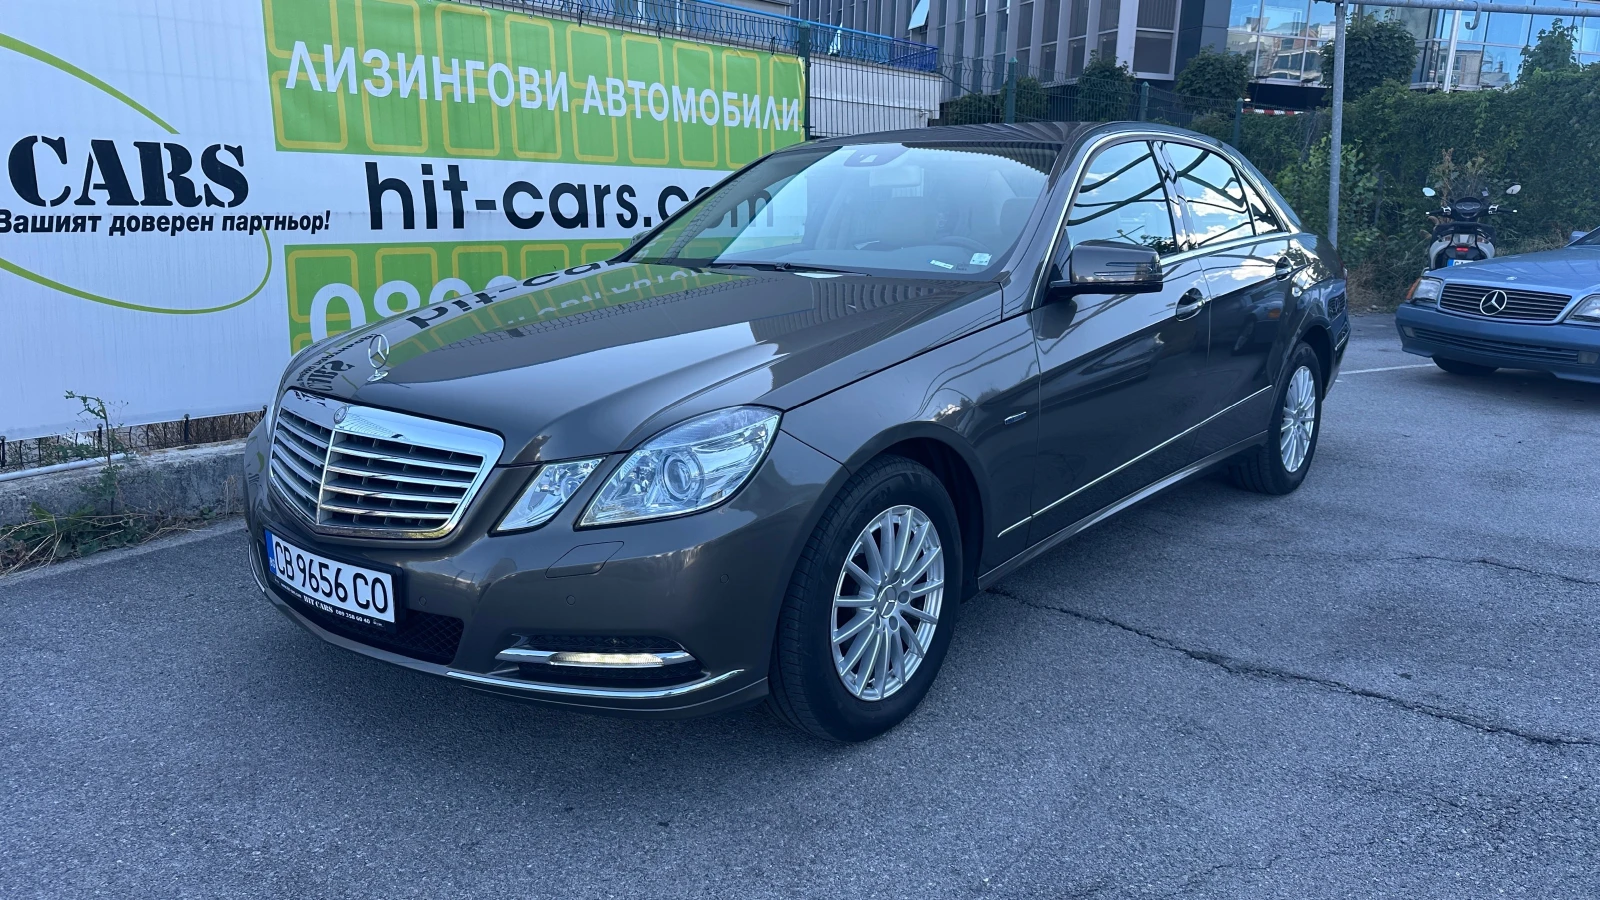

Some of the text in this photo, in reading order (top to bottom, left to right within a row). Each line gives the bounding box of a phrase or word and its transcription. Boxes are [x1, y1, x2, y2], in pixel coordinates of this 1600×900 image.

[285, 40, 799, 132] ЛИЗИНГОВИ АВТОМОБИЛИ
[7, 135, 249, 208] CARS
[0, 209, 331, 236] Вашият доверен партньор!
[275, 541, 295, 581] CB
[296, 553, 349, 603] 9656
[352, 572, 388, 614] CO
[315, 600, 334, 613] CARS
